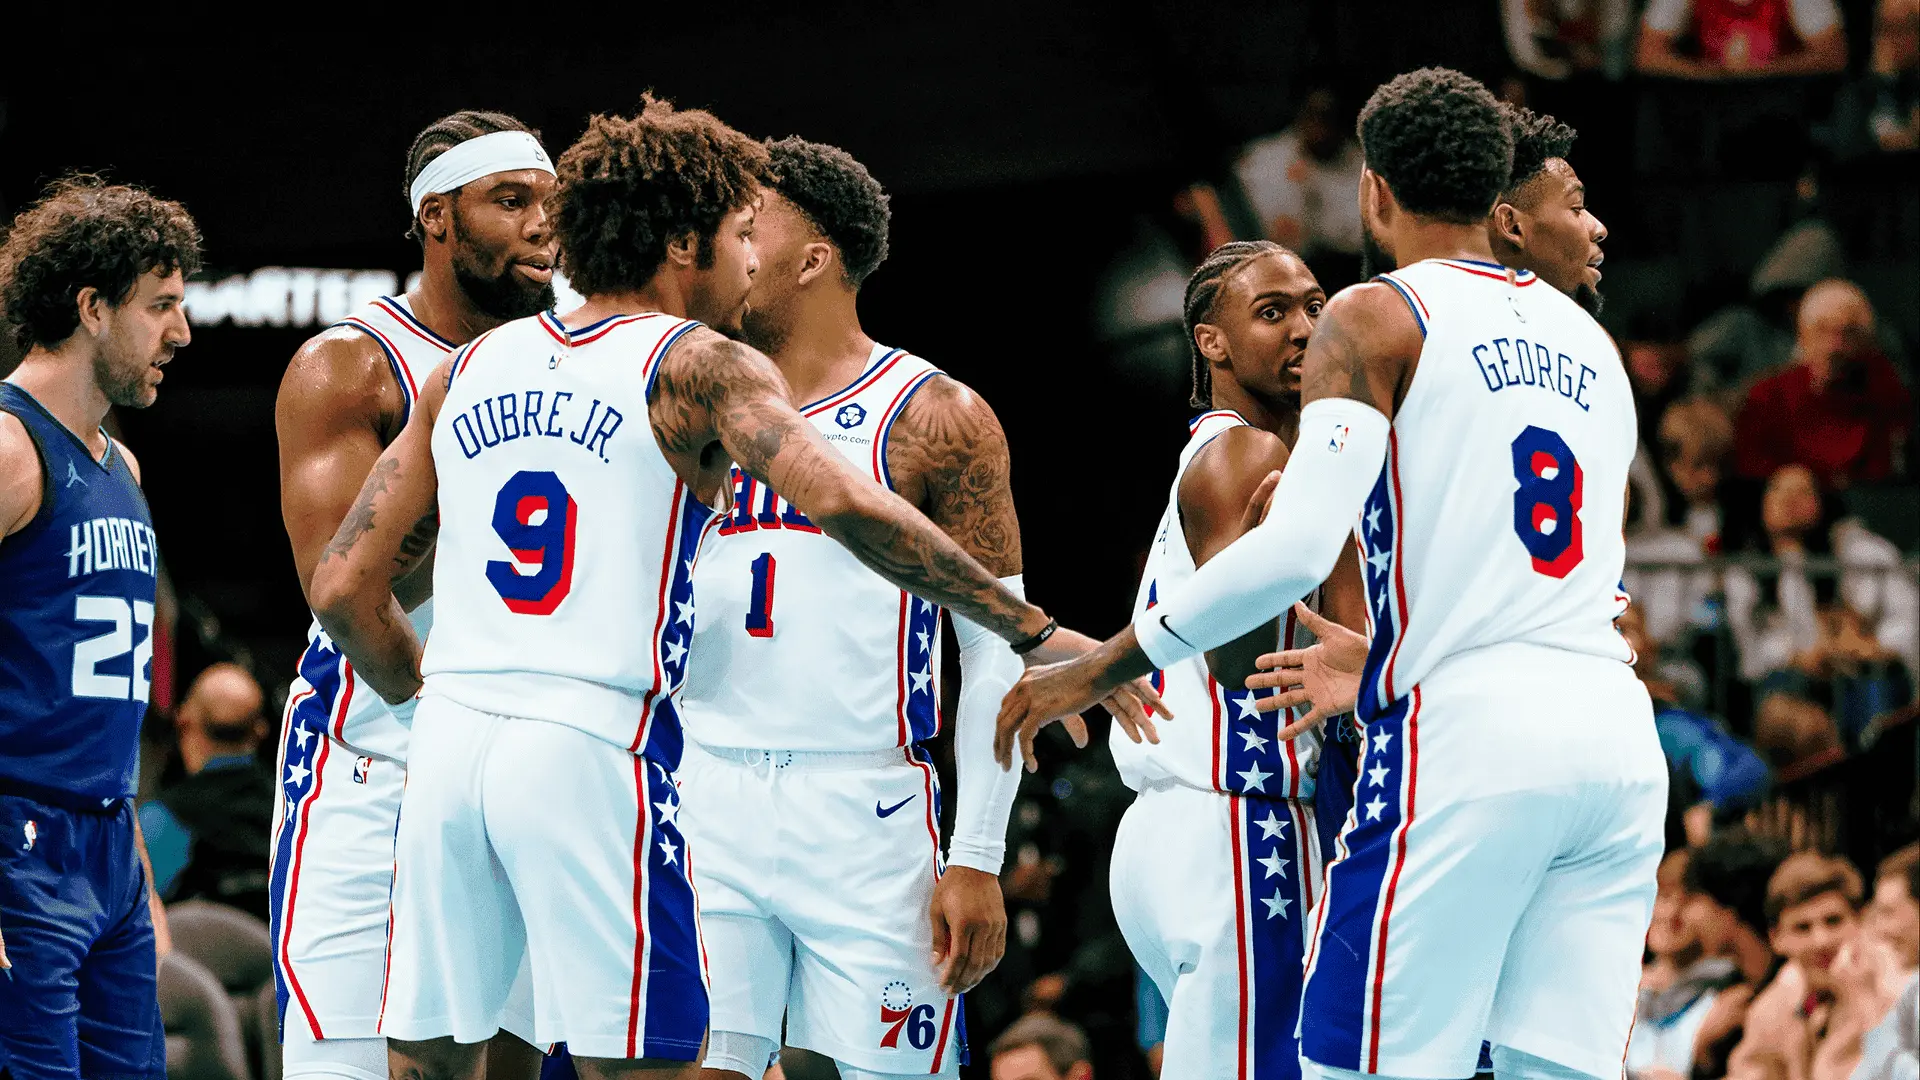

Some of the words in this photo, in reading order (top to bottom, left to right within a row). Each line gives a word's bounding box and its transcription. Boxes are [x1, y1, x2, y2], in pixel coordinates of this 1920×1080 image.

[1472, 338, 1597, 412] GEORGE
[452, 390, 573, 459] OUBRE
[569, 399, 624, 464] JR.
[1511, 424, 1584, 580] 8
[485, 470, 578, 616] 9
[745, 552, 776, 638] 1
[880, 1004, 936, 1050] 76
